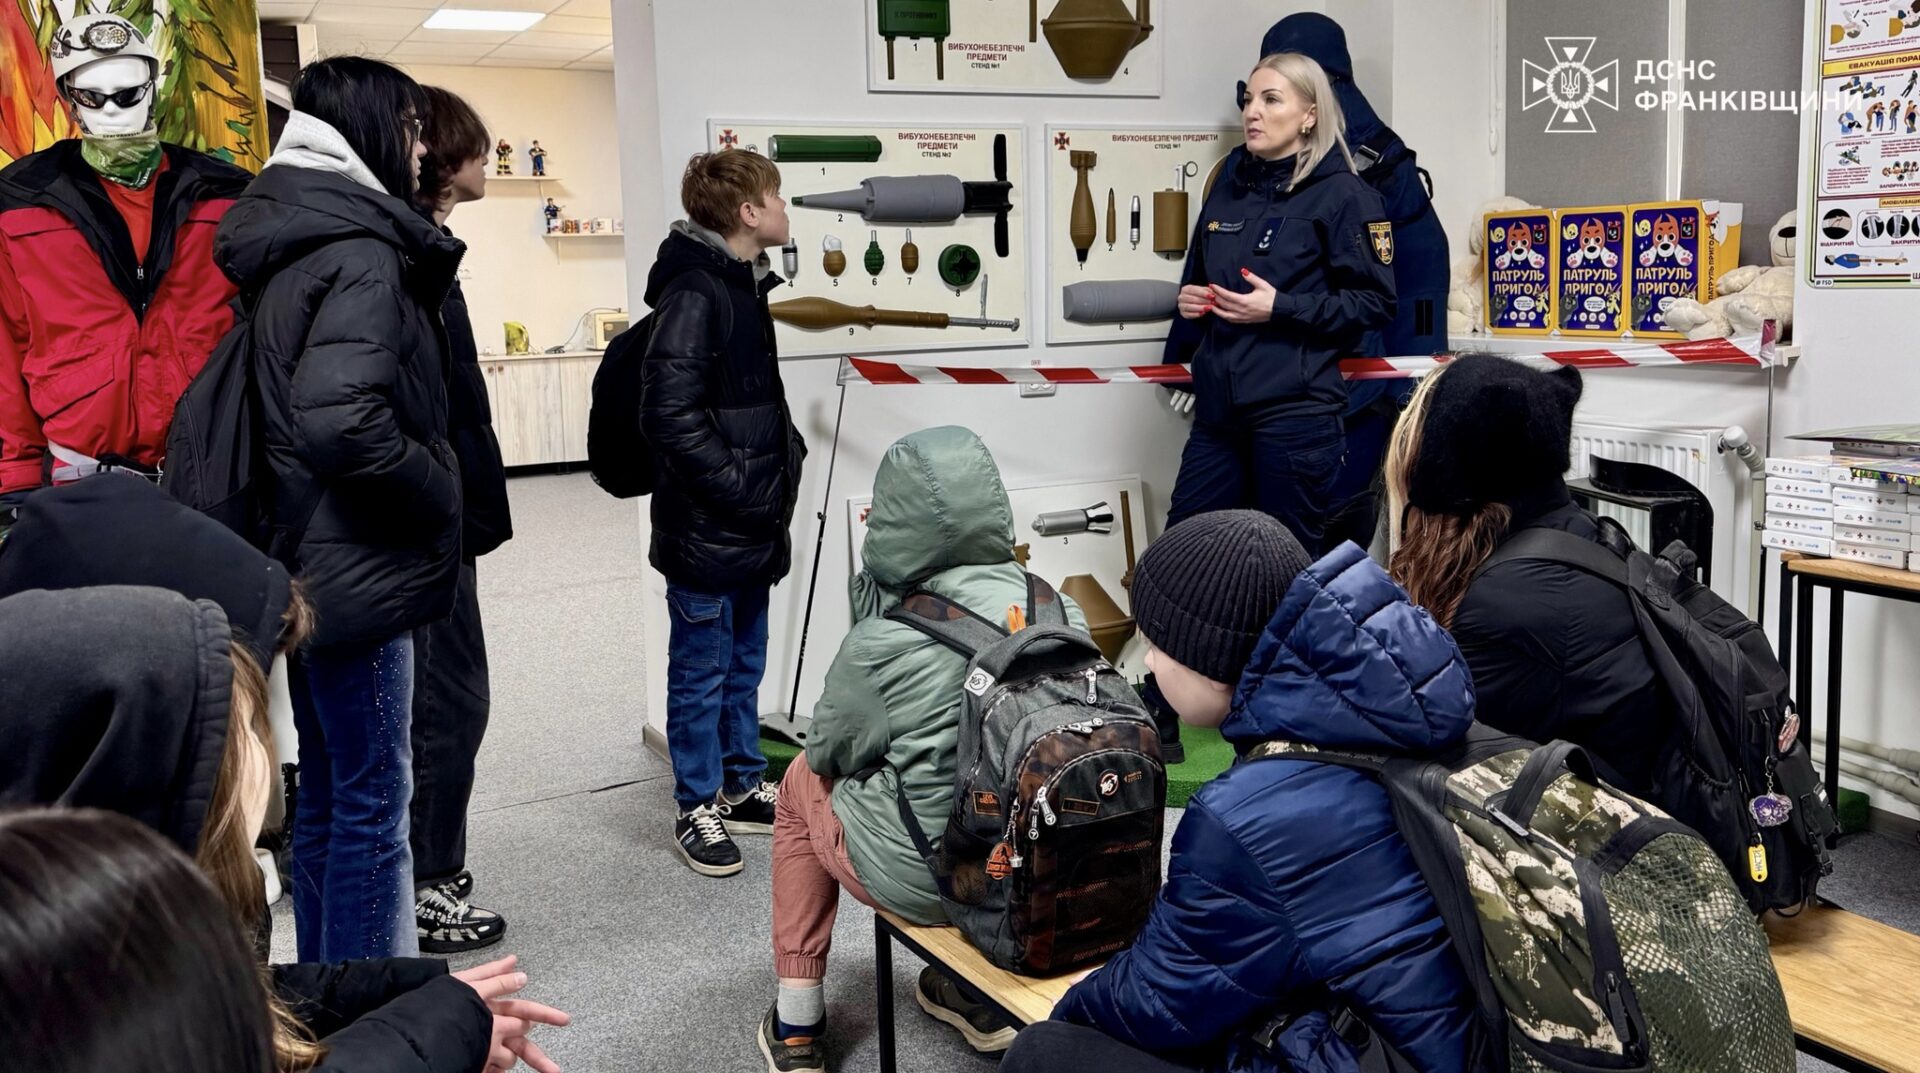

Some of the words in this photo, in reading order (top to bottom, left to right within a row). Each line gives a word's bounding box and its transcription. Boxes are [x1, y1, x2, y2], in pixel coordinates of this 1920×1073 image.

[913, 42, 918, 52] 1
[948, 43, 1025, 52] ВИБУХОНЕБЕЗПЕЧНІ
[966, 53, 1008, 62] ПРЕДМЕТИ
[1124, 67, 1128, 76] 4
[898, 132, 976, 141] ВИБУХОНЕБЕЗПЕЧНІ
[1182, 134, 1218, 142] ПРЕДМЕТИ
[821, 167, 826, 176] 1
[838, 214, 843, 222] 2
[1492, 270, 1545, 282] ПАТРУЛЬ
[1564, 268, 1618, 281] ПАТРУЛЬ
[1636, 268, 1692, 280] ПАТРУЛЬ
[788, 279, 794, 288] 4
[833, 278, 838, 287] 5
[872, 278, 877, 286] 6
[956, 289, 961, 297] 8
[1494, 284, 1540, 296] ПРИГОД
[1565, 283, 1612, 296] ПРИГОД
[1638, 282, 1688, 296] ПРИГОД
[1119, 322, 1124, 330] 6
[849, 327, 854, 336] 9
[1063, 537, 1069, 545] 3
